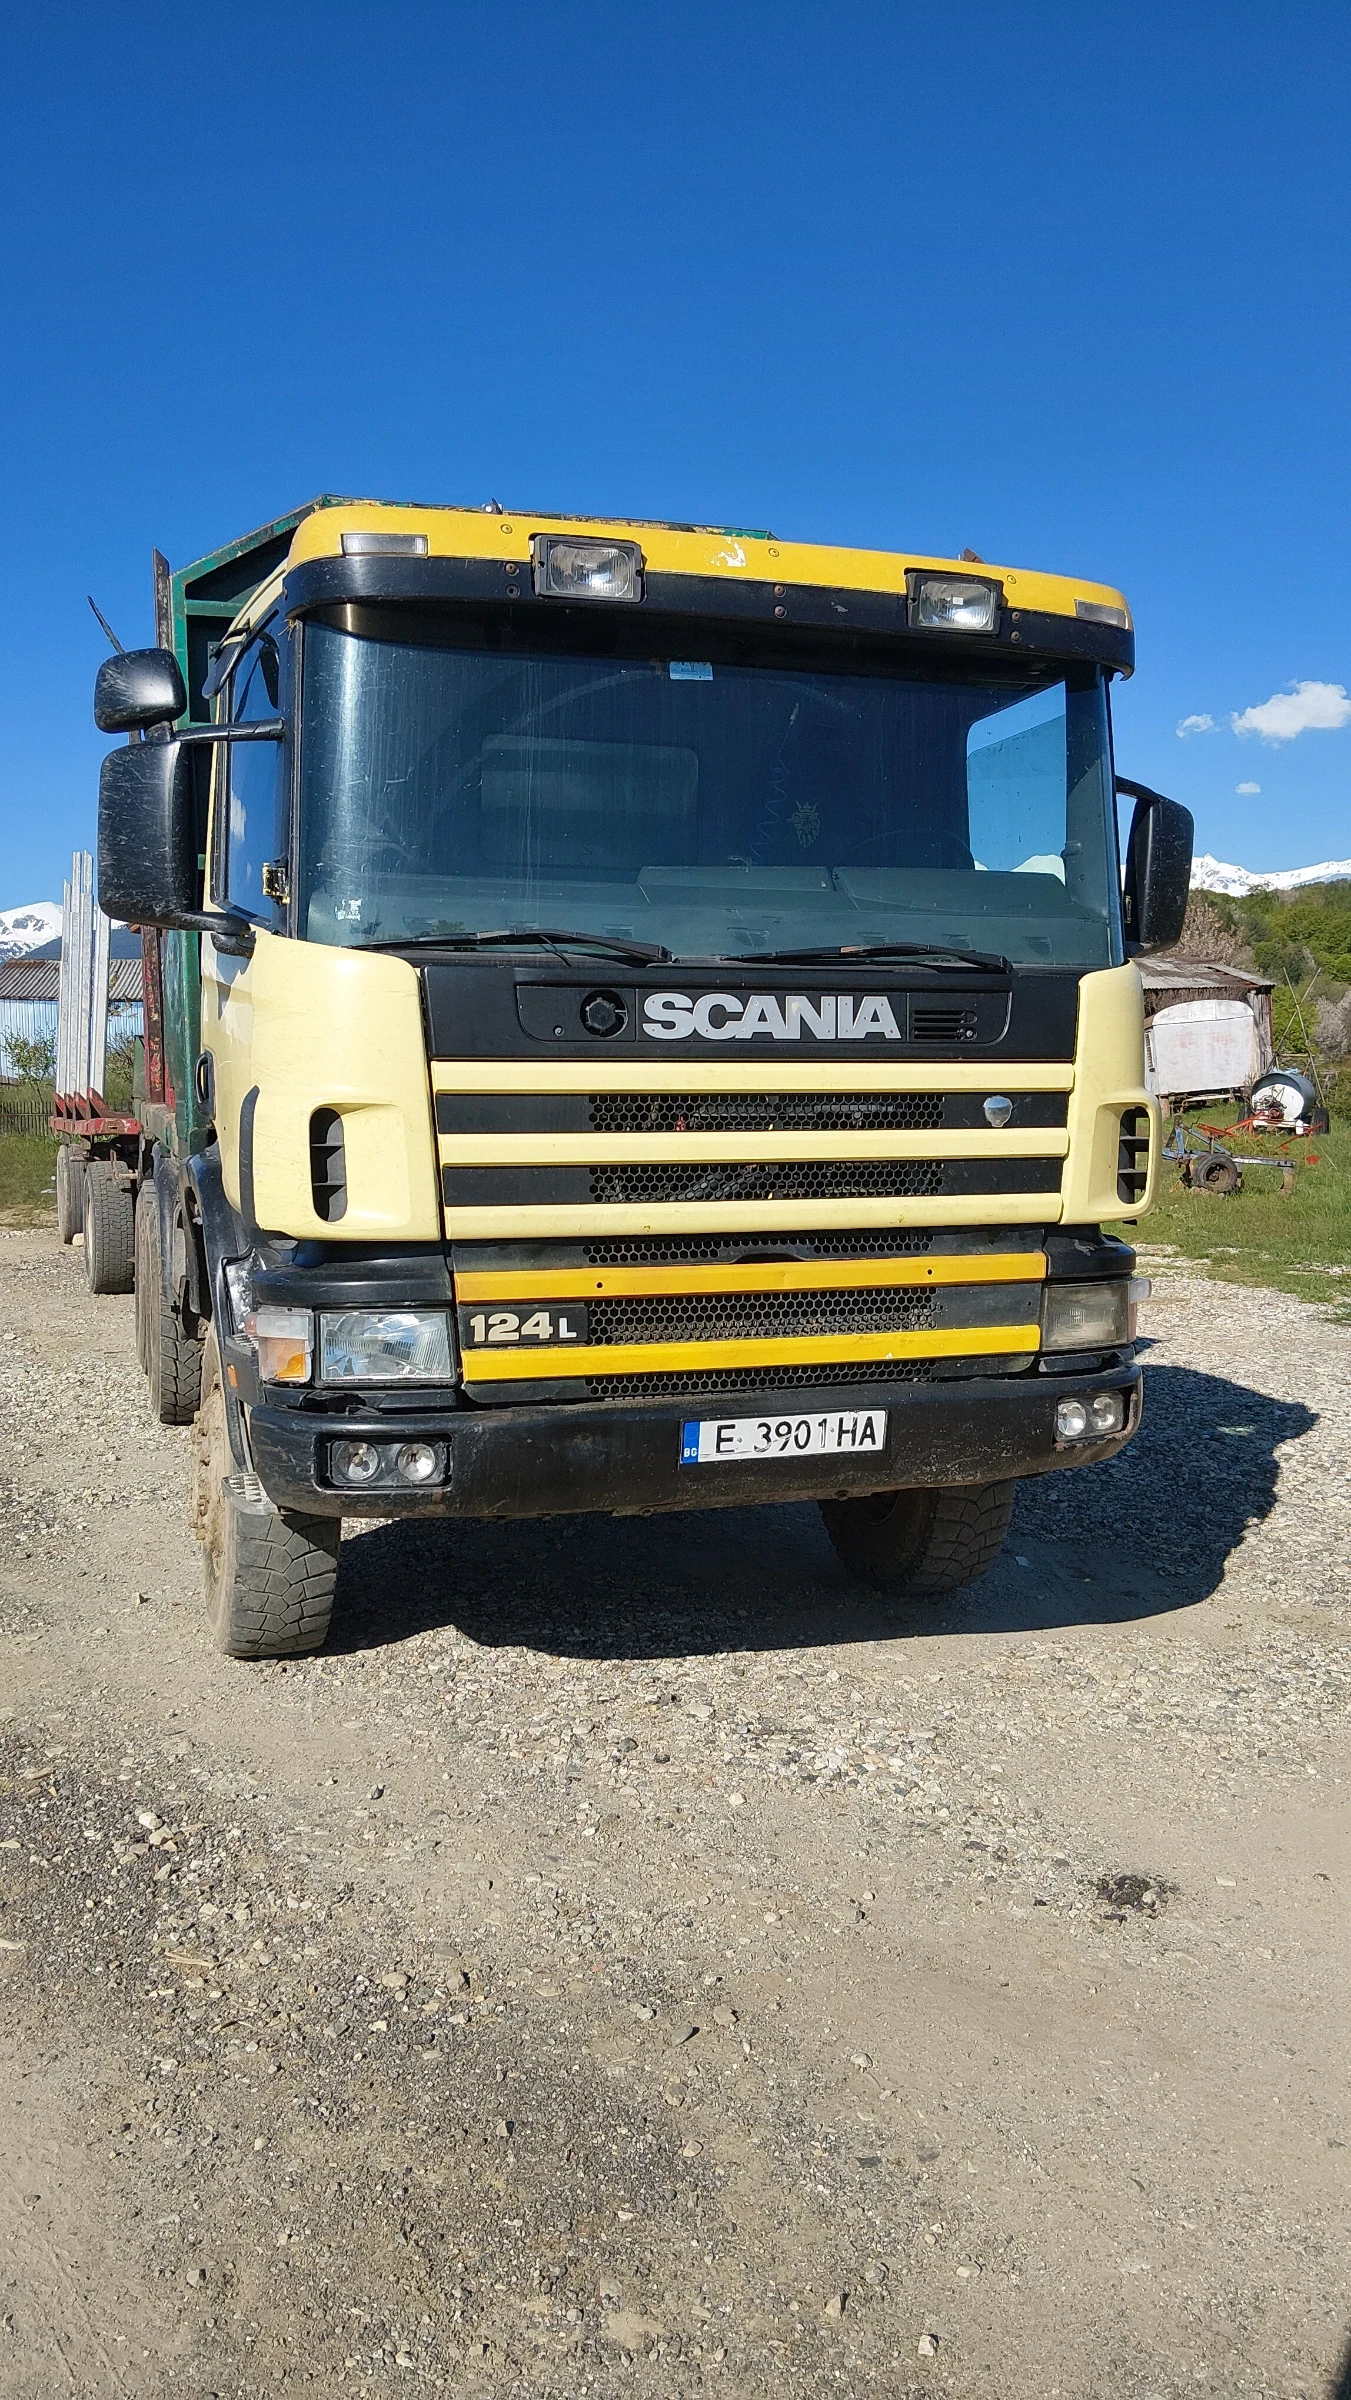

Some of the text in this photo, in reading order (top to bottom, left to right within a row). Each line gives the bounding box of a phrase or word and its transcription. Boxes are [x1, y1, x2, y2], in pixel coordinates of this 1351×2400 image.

[642, 993, 901, 1040] SCANIA
[470, 1312, 577, 1343] 124 L
[683, 1447, 697, 1458] BG
[715, 1423, 736, 1454] E
